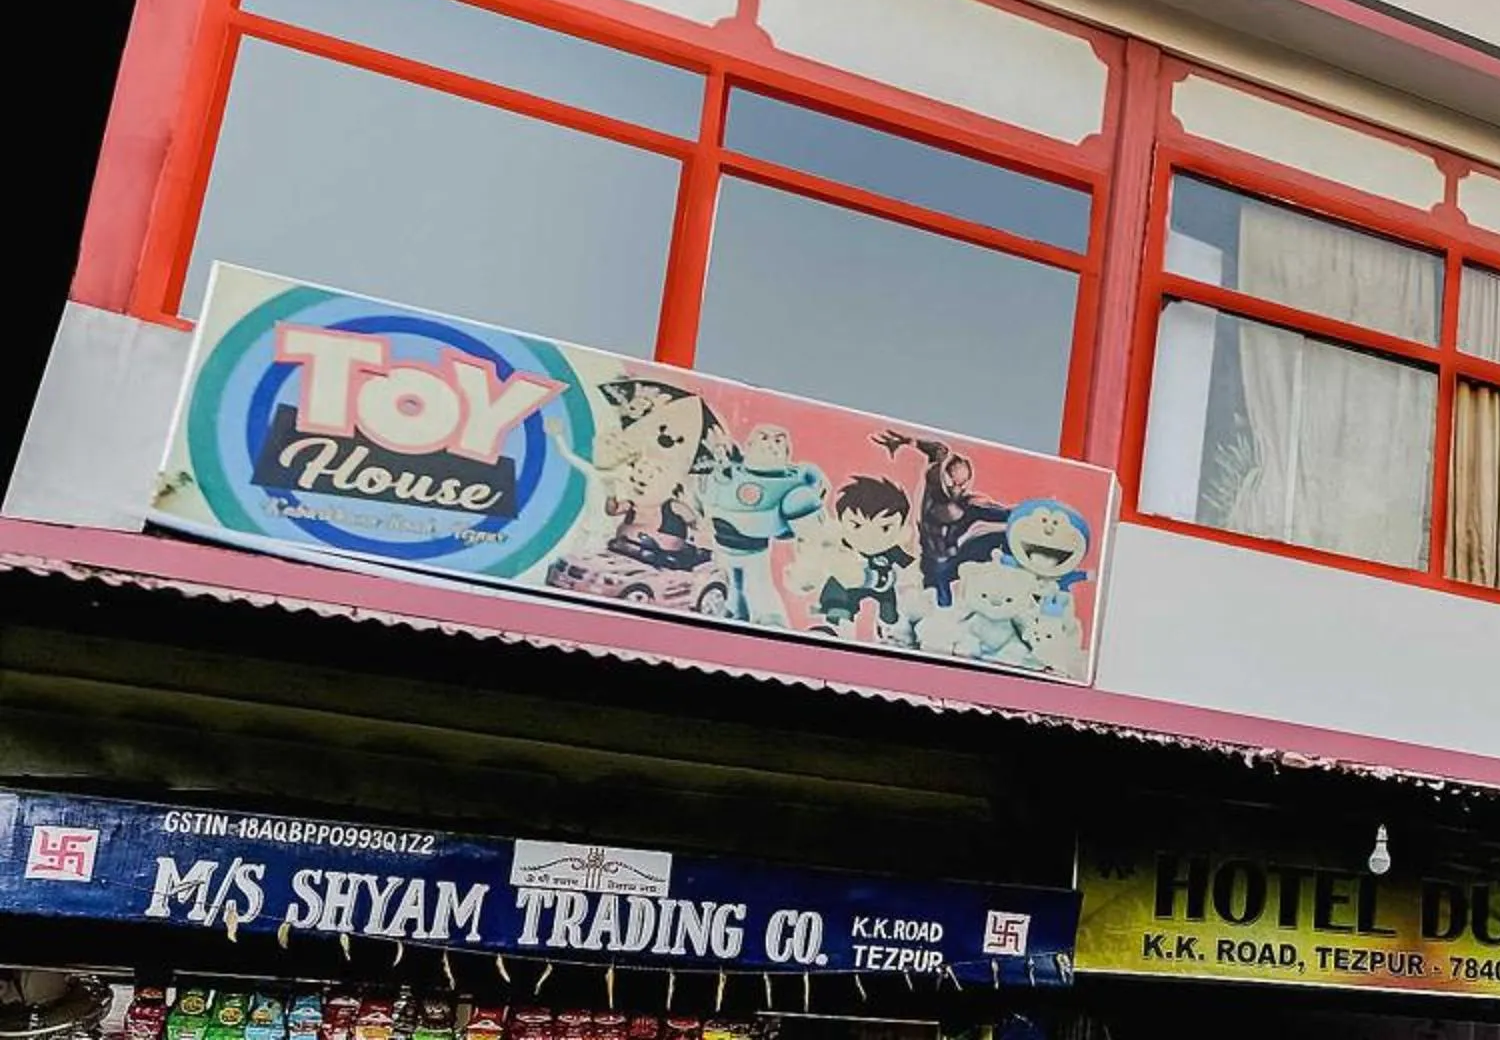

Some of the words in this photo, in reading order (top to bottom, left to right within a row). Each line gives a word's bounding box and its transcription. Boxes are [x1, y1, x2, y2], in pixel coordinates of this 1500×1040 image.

[279, 437, 501, 509] House
[145, 857, 266, 926] M/S
[286, 869, 489, 942] SHYAM
[515, 888, 746, 959] TRADING
[766, 909, 828, 966] CO.
[1153, 850, 1396, 936] HOTEL
[851, 945, 944, 974] TEZPUR
[1142, 933, 1205, 960] K.K.
[1217, 939, 1305, 975] ROAD,
[1315, 947, 1424, 976] TEZPUR
